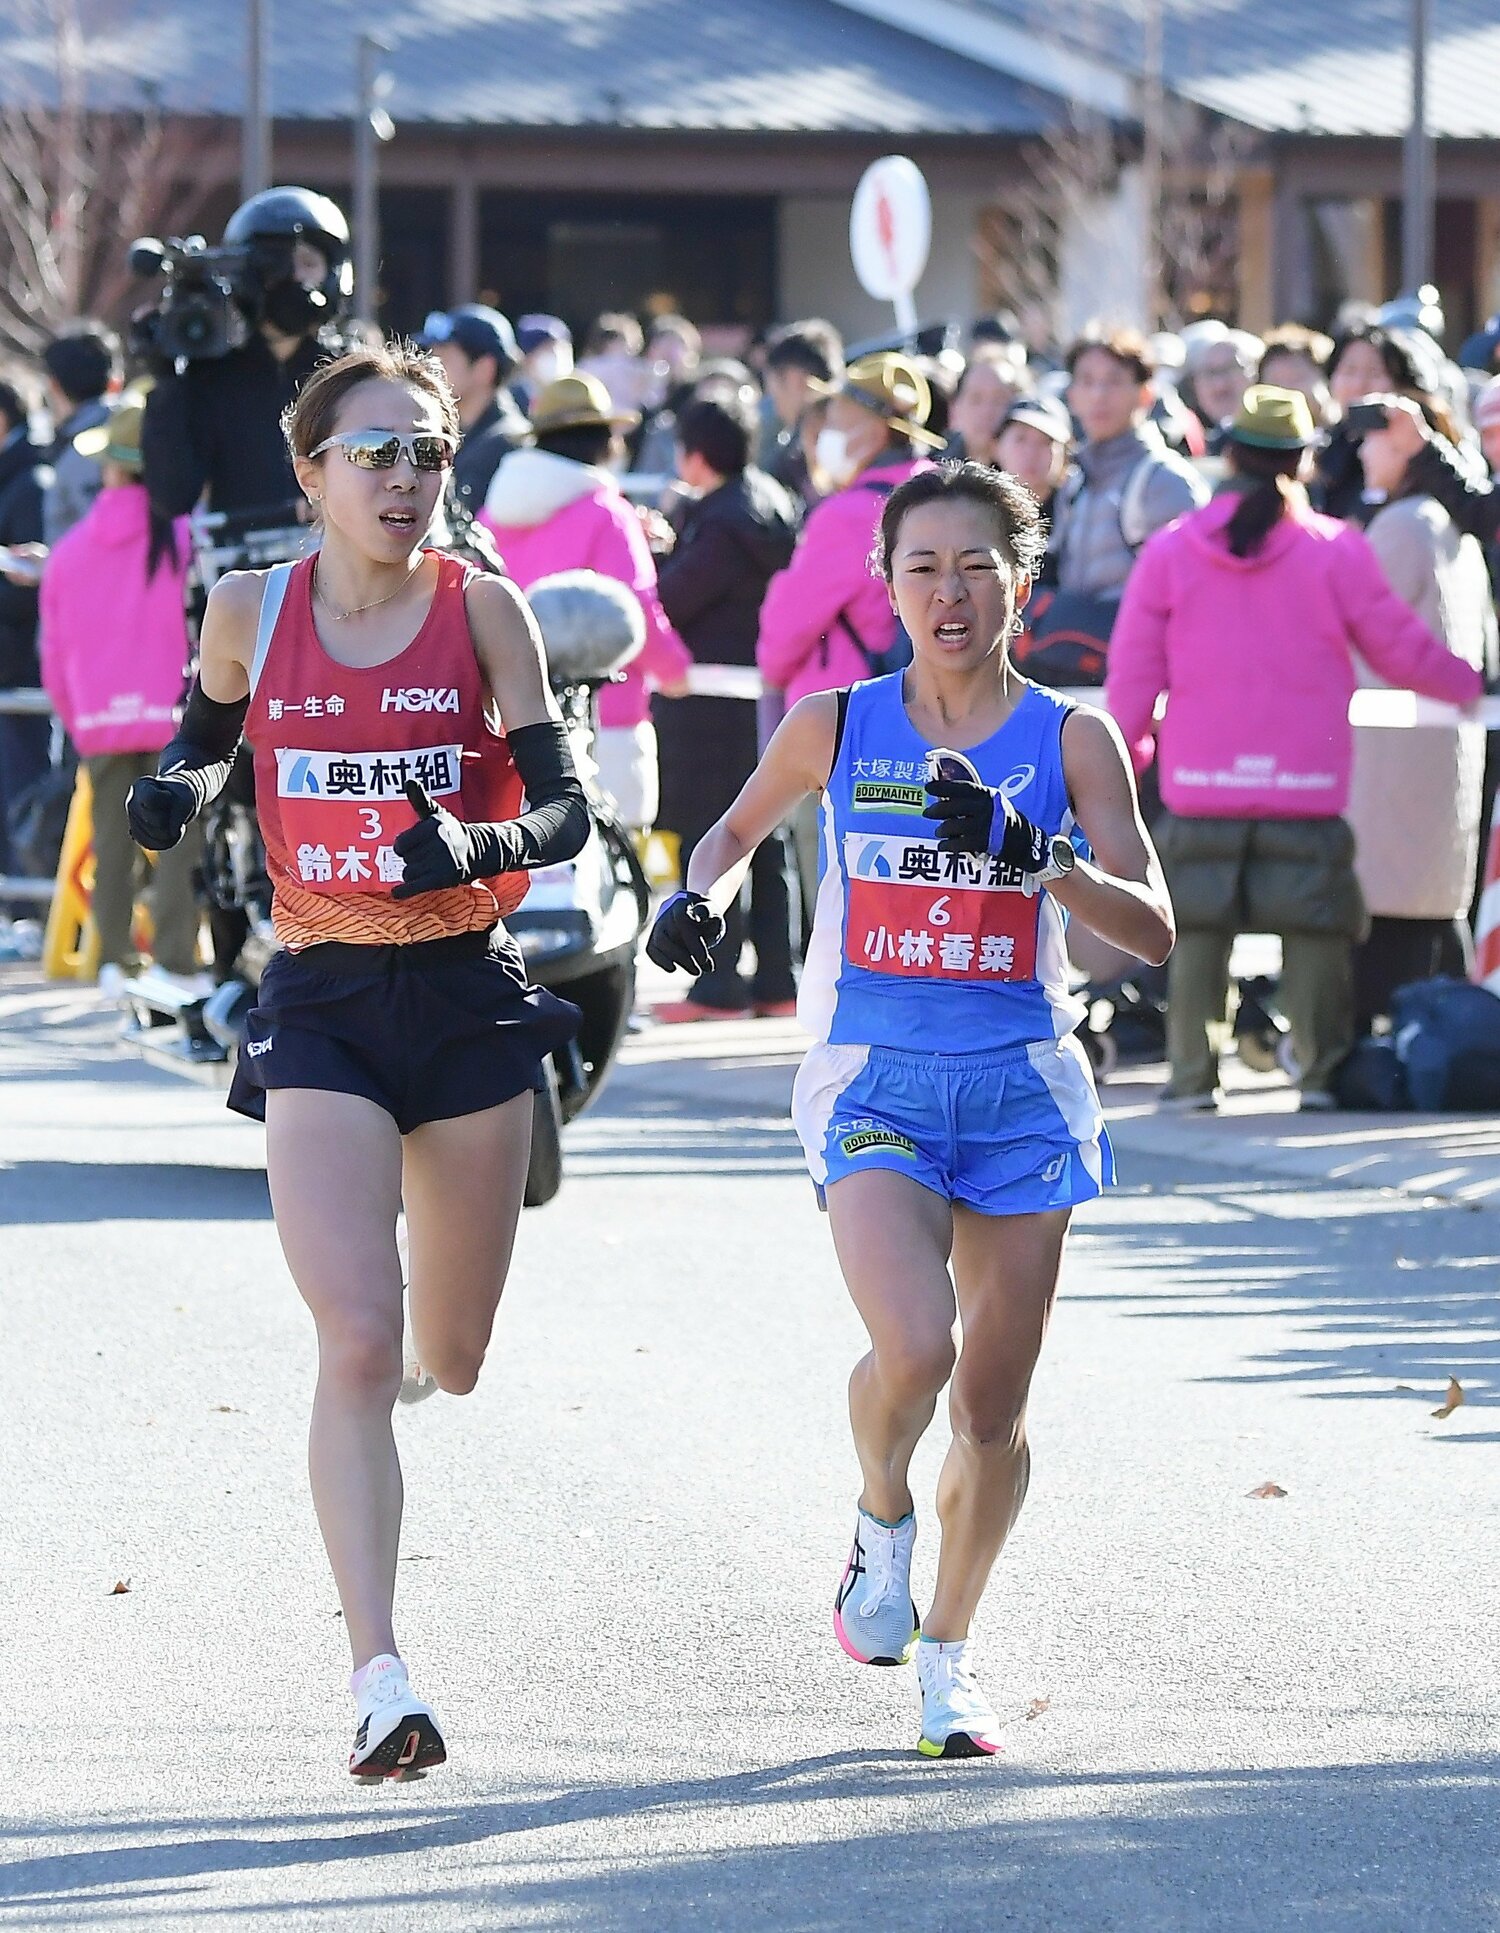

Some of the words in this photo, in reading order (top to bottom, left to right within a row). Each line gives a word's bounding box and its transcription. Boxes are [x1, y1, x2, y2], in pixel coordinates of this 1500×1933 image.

[268, 694, 346, 721] 第一生命
[380, 688, 460, 713] HOKA
[326, 751, 452, 795] 奥村組
[358, 807, 383, 840] 3
[296, 843, 408, 883] 鈴木優
[928, 895, 951, 926] 6
[864, 926, 1015, 972] 小林香菜
